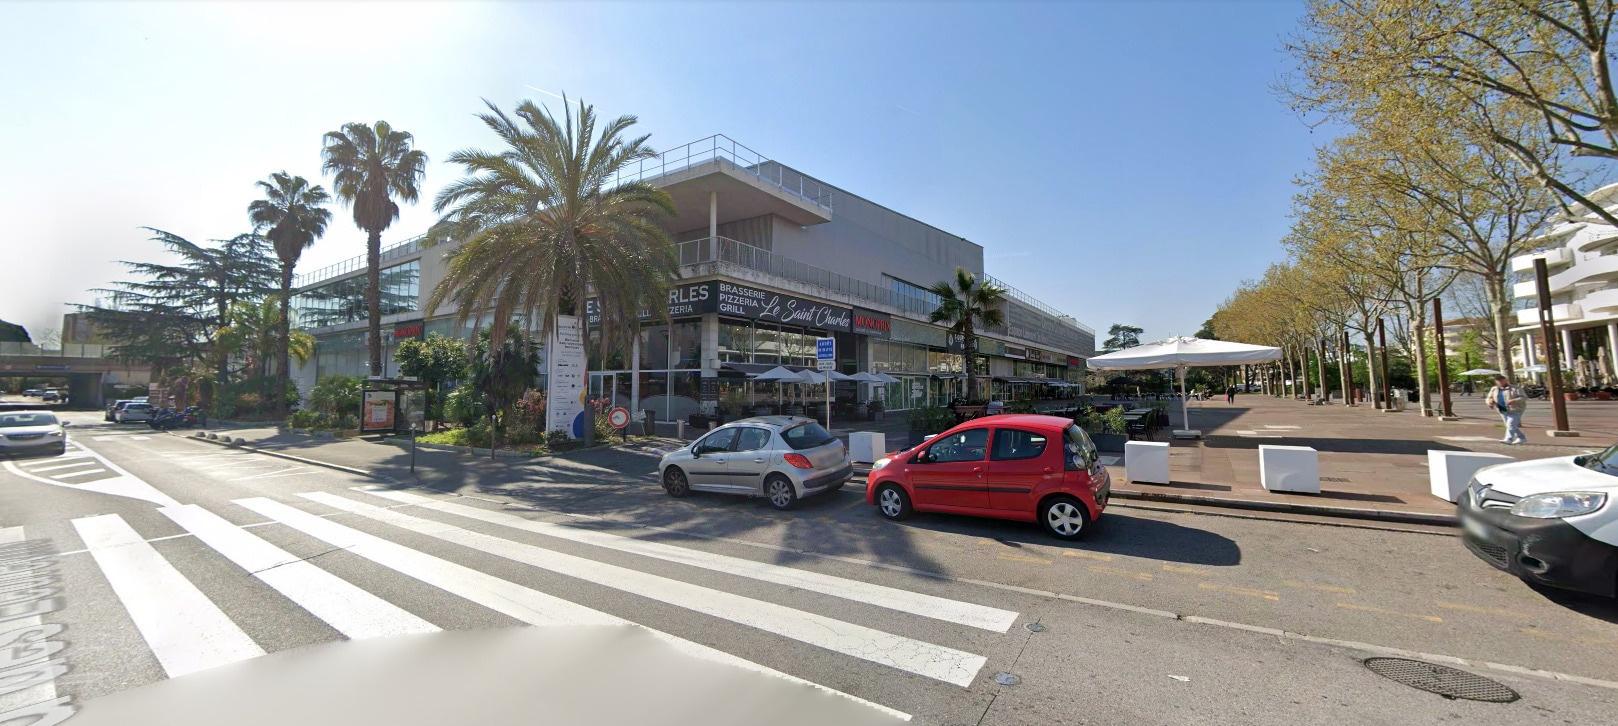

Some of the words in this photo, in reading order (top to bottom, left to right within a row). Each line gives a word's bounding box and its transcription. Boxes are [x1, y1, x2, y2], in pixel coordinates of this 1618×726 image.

[669, 284, 709, 304] RLES
[719, 283, 766, 300] BRASSERIE
[719, 293, 759, 308] PIZZERIA
[719, 303, 746, 315] GRILL
[668, 304, 693, 315] ZERIA
[759, 295, 781, 318] Le
[781, 299, 818, 322] Saint
[815, 306, 850, 328] Charles
[855, 314, 891, 332] MONOPRIX
